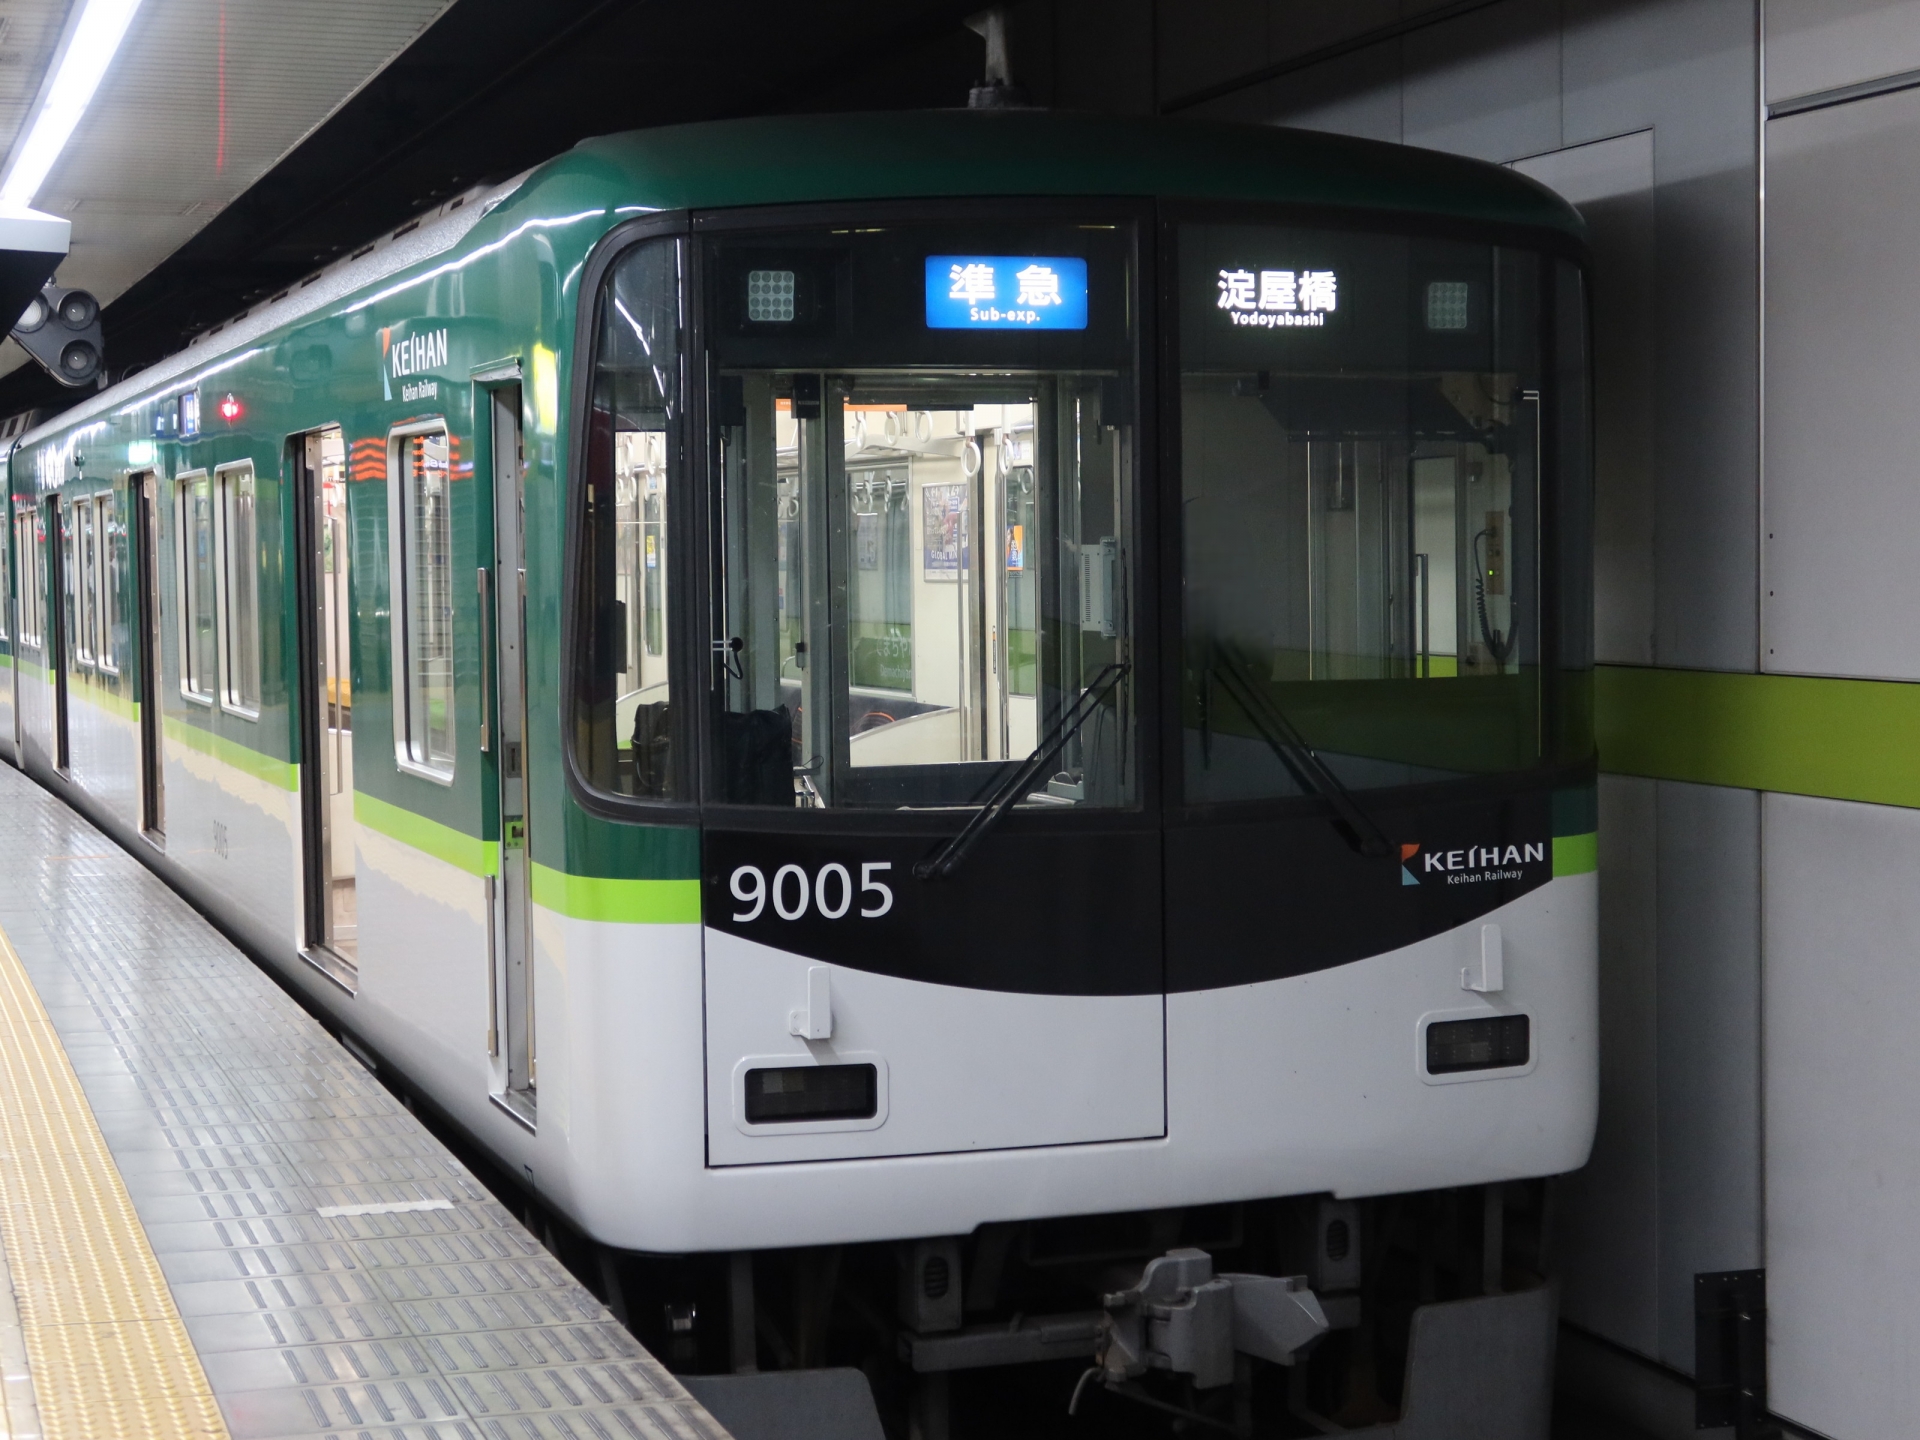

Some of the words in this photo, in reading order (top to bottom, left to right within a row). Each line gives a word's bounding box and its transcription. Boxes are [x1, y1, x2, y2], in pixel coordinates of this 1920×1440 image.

[949, 263, 1062, 305] 準急
[1217, 269, 1337, 311] 淀屋橋
[970, 307, 1040, 324] Sub-exp.
[1231, 311, 1324, 328] Yodoyabashi
[391, 328, 447, 378] KEIHAN
[402, 383, 418, 402] Keihan
[419, 379, 437, 400] Railway
[1424, 843, 1544, 872] KEIHAN
[1447, 873, 1482, 885] Keihan
[1485, 869, 1523, 883] Railway
[729, 862, 893, 922] 9005
